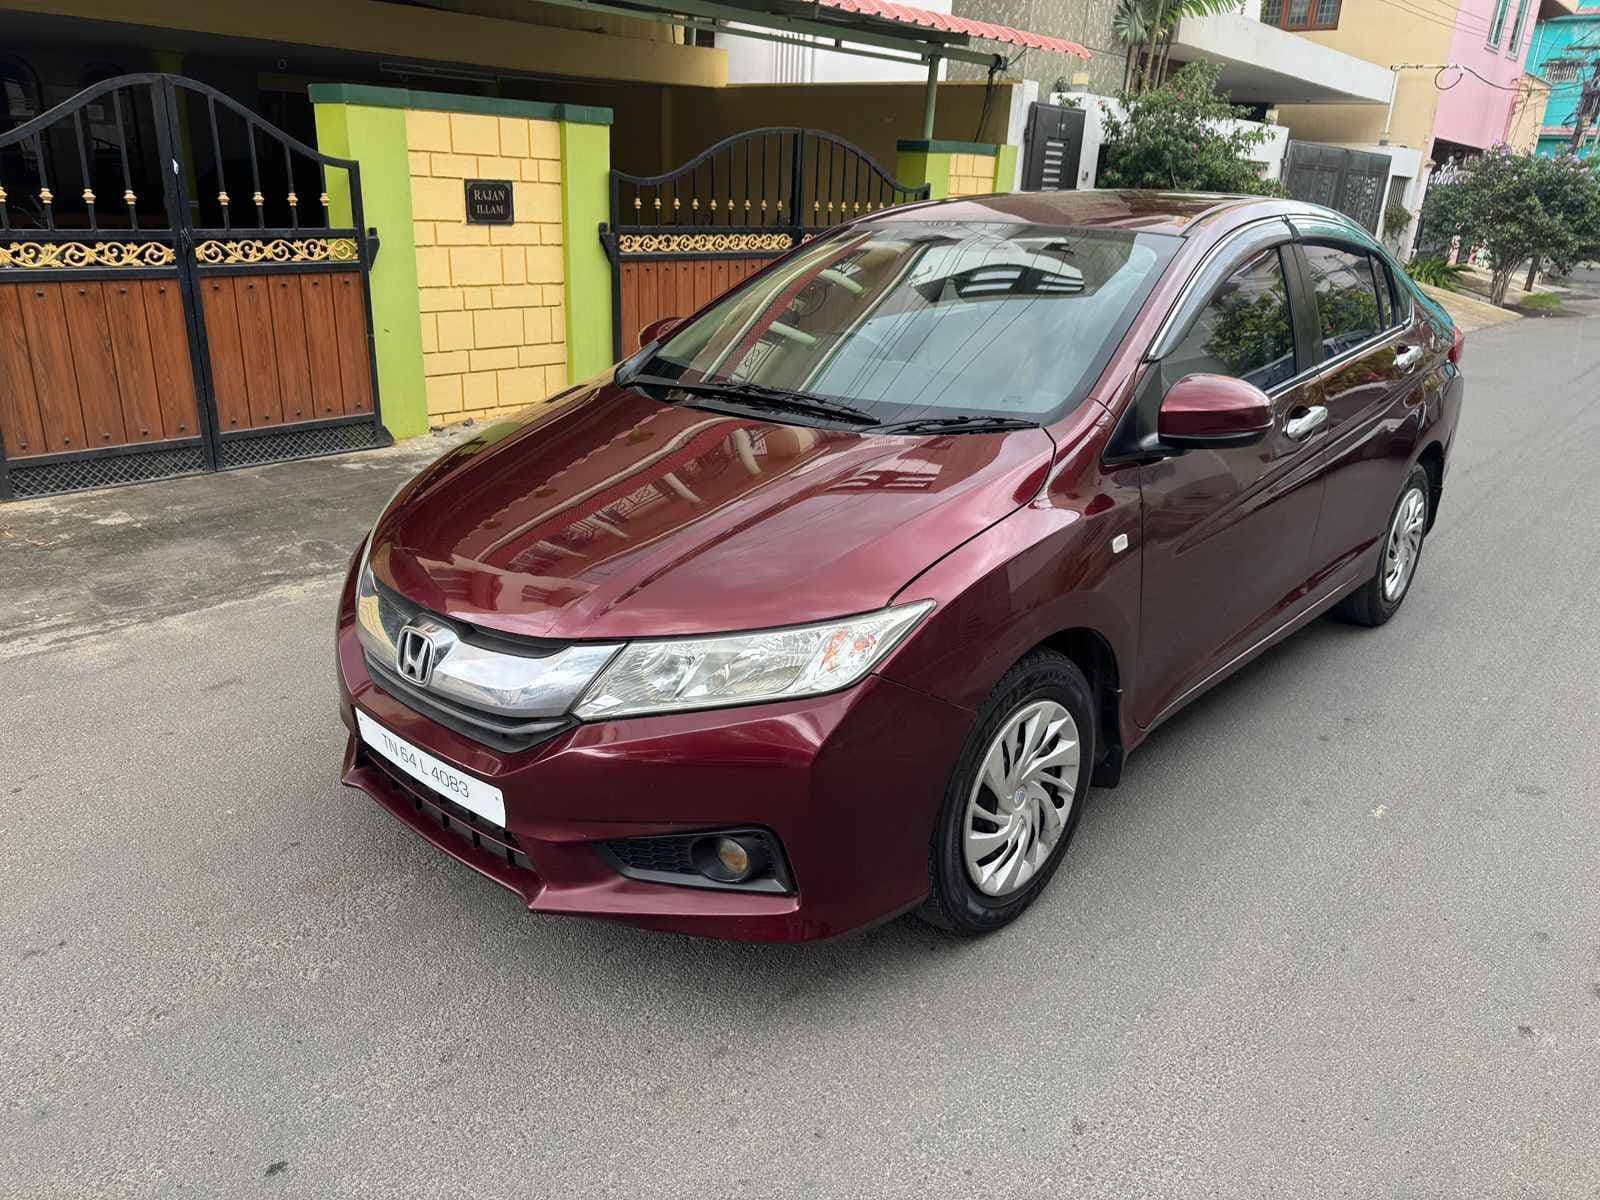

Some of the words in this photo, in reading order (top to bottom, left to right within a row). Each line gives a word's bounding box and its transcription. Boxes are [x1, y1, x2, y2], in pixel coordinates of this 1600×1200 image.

[473, 189, 505, 201] RAJAN
[476, 204, 504, 216] ILLAM
[381, 732, 399, 757] TN
[400, 746, 417, 769] 64
[419, 758, 429, 776] L
[431, 766, 470, 798] 4083
